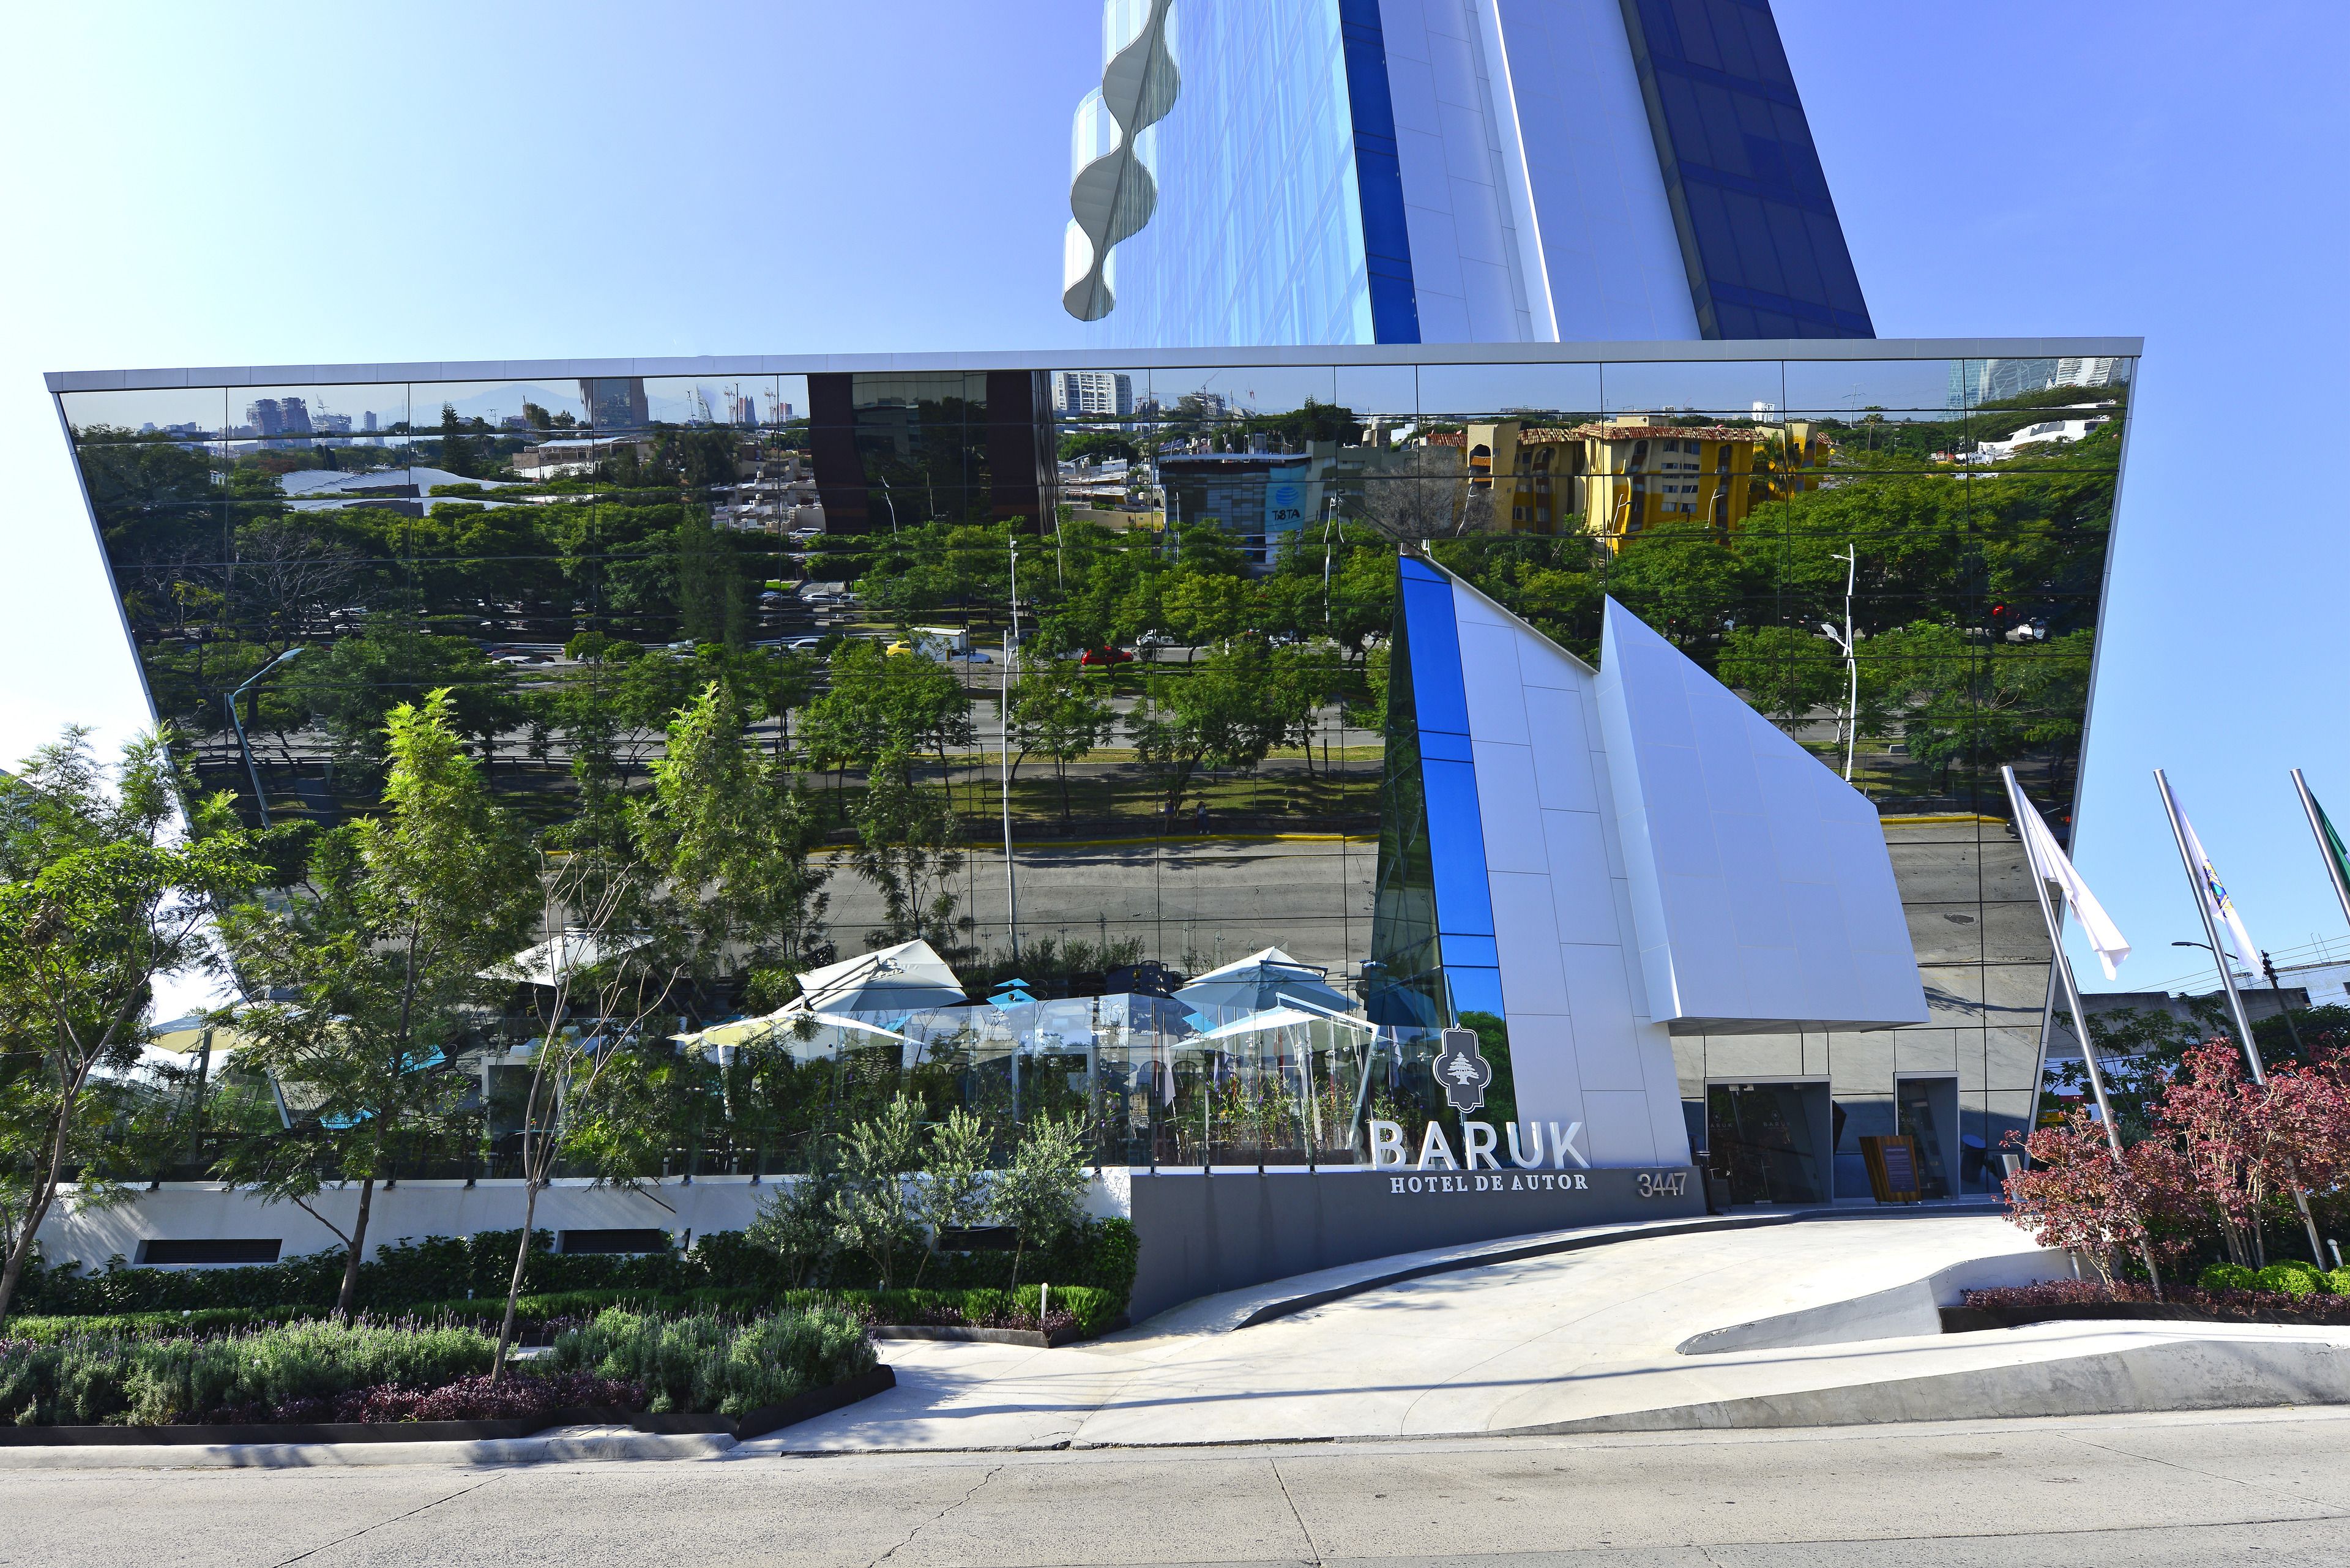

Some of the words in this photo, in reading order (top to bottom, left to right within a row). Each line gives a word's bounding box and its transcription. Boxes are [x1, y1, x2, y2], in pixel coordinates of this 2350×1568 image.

[1370, 1121, 1591, 1171] BARUK
[1390, 1176, 1468, 1193] HOTEL
[1475, 1175, 1504, 1192] DE
[1511, 1174, 1589, 1191] AUTOR
[1637, 1172, 1687, 1198] 3447
